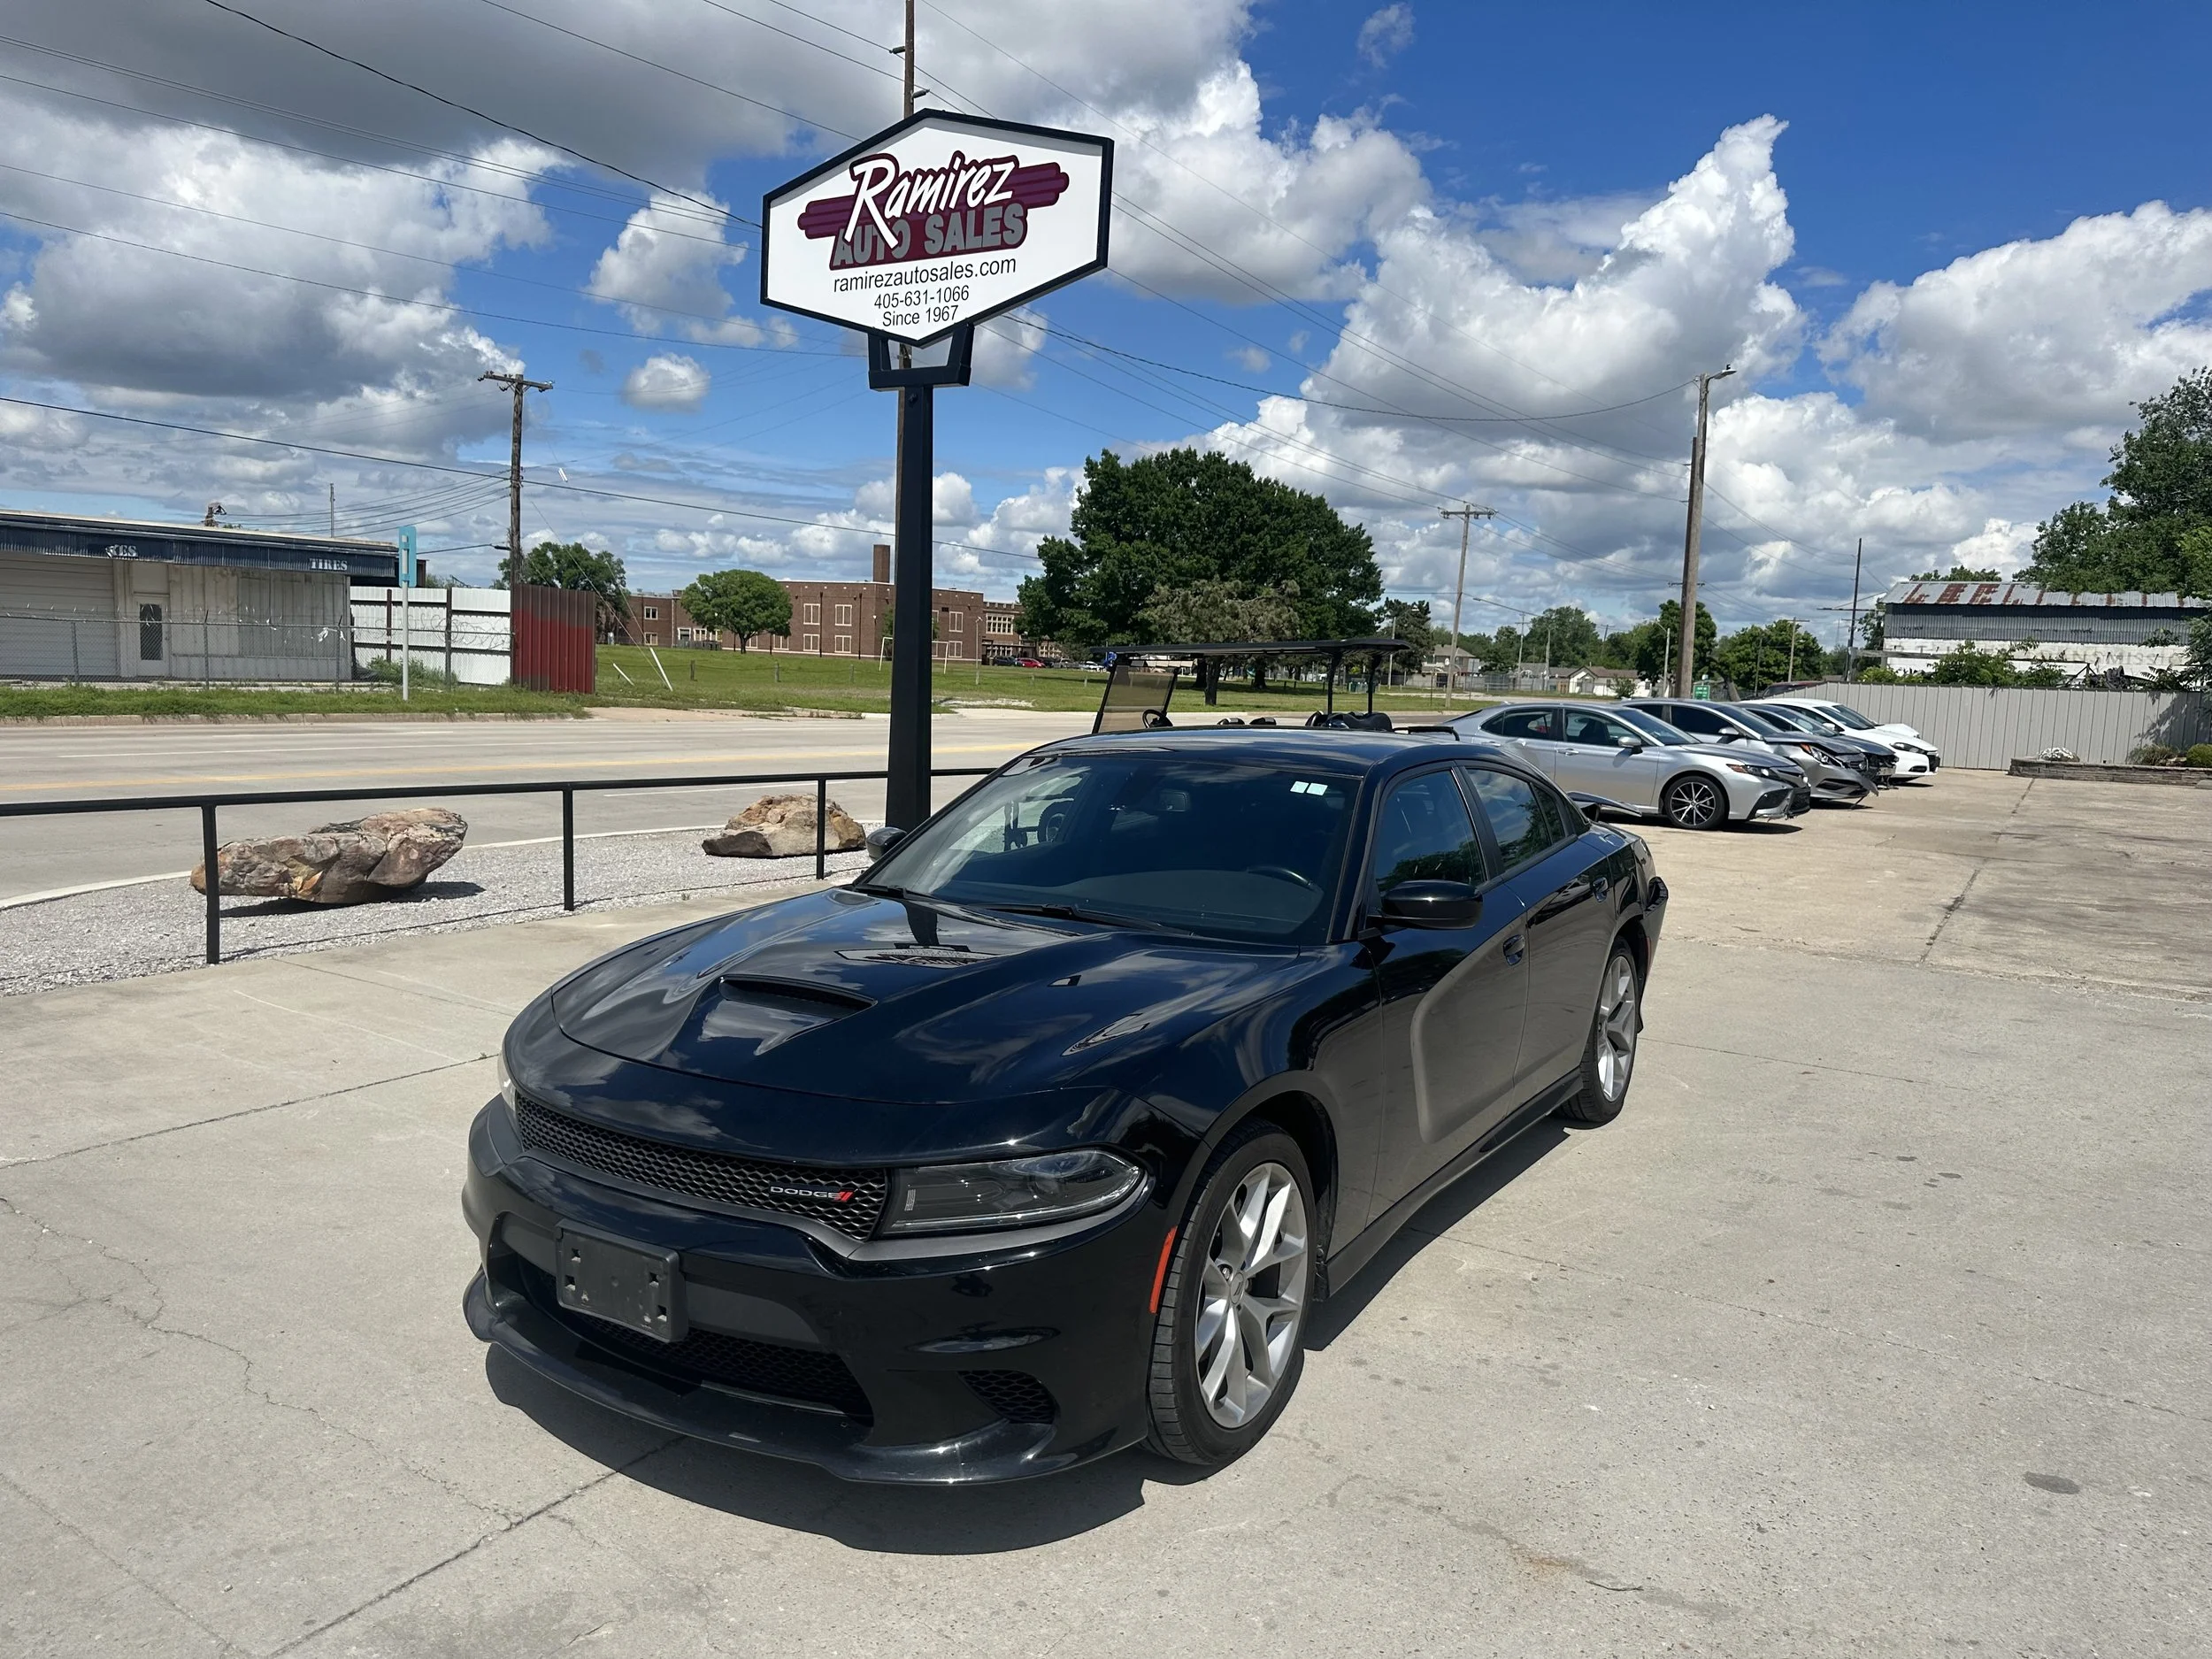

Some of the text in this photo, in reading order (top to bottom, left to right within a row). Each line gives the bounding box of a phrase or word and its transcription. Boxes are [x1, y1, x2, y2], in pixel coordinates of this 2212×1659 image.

[844, 156, 1016, 249] Ramirez
[833, 203, 1024, 266] AUTO SALES
[833, 257, 1017, 293] ramirezautosales.com
[873, 284, 970, 310] 405-631-1066
[882, 304, 959, 327] Since 1967
[310, 557, 348, 571] TIRES
[770, 1186, 842, 1199] DODGE
